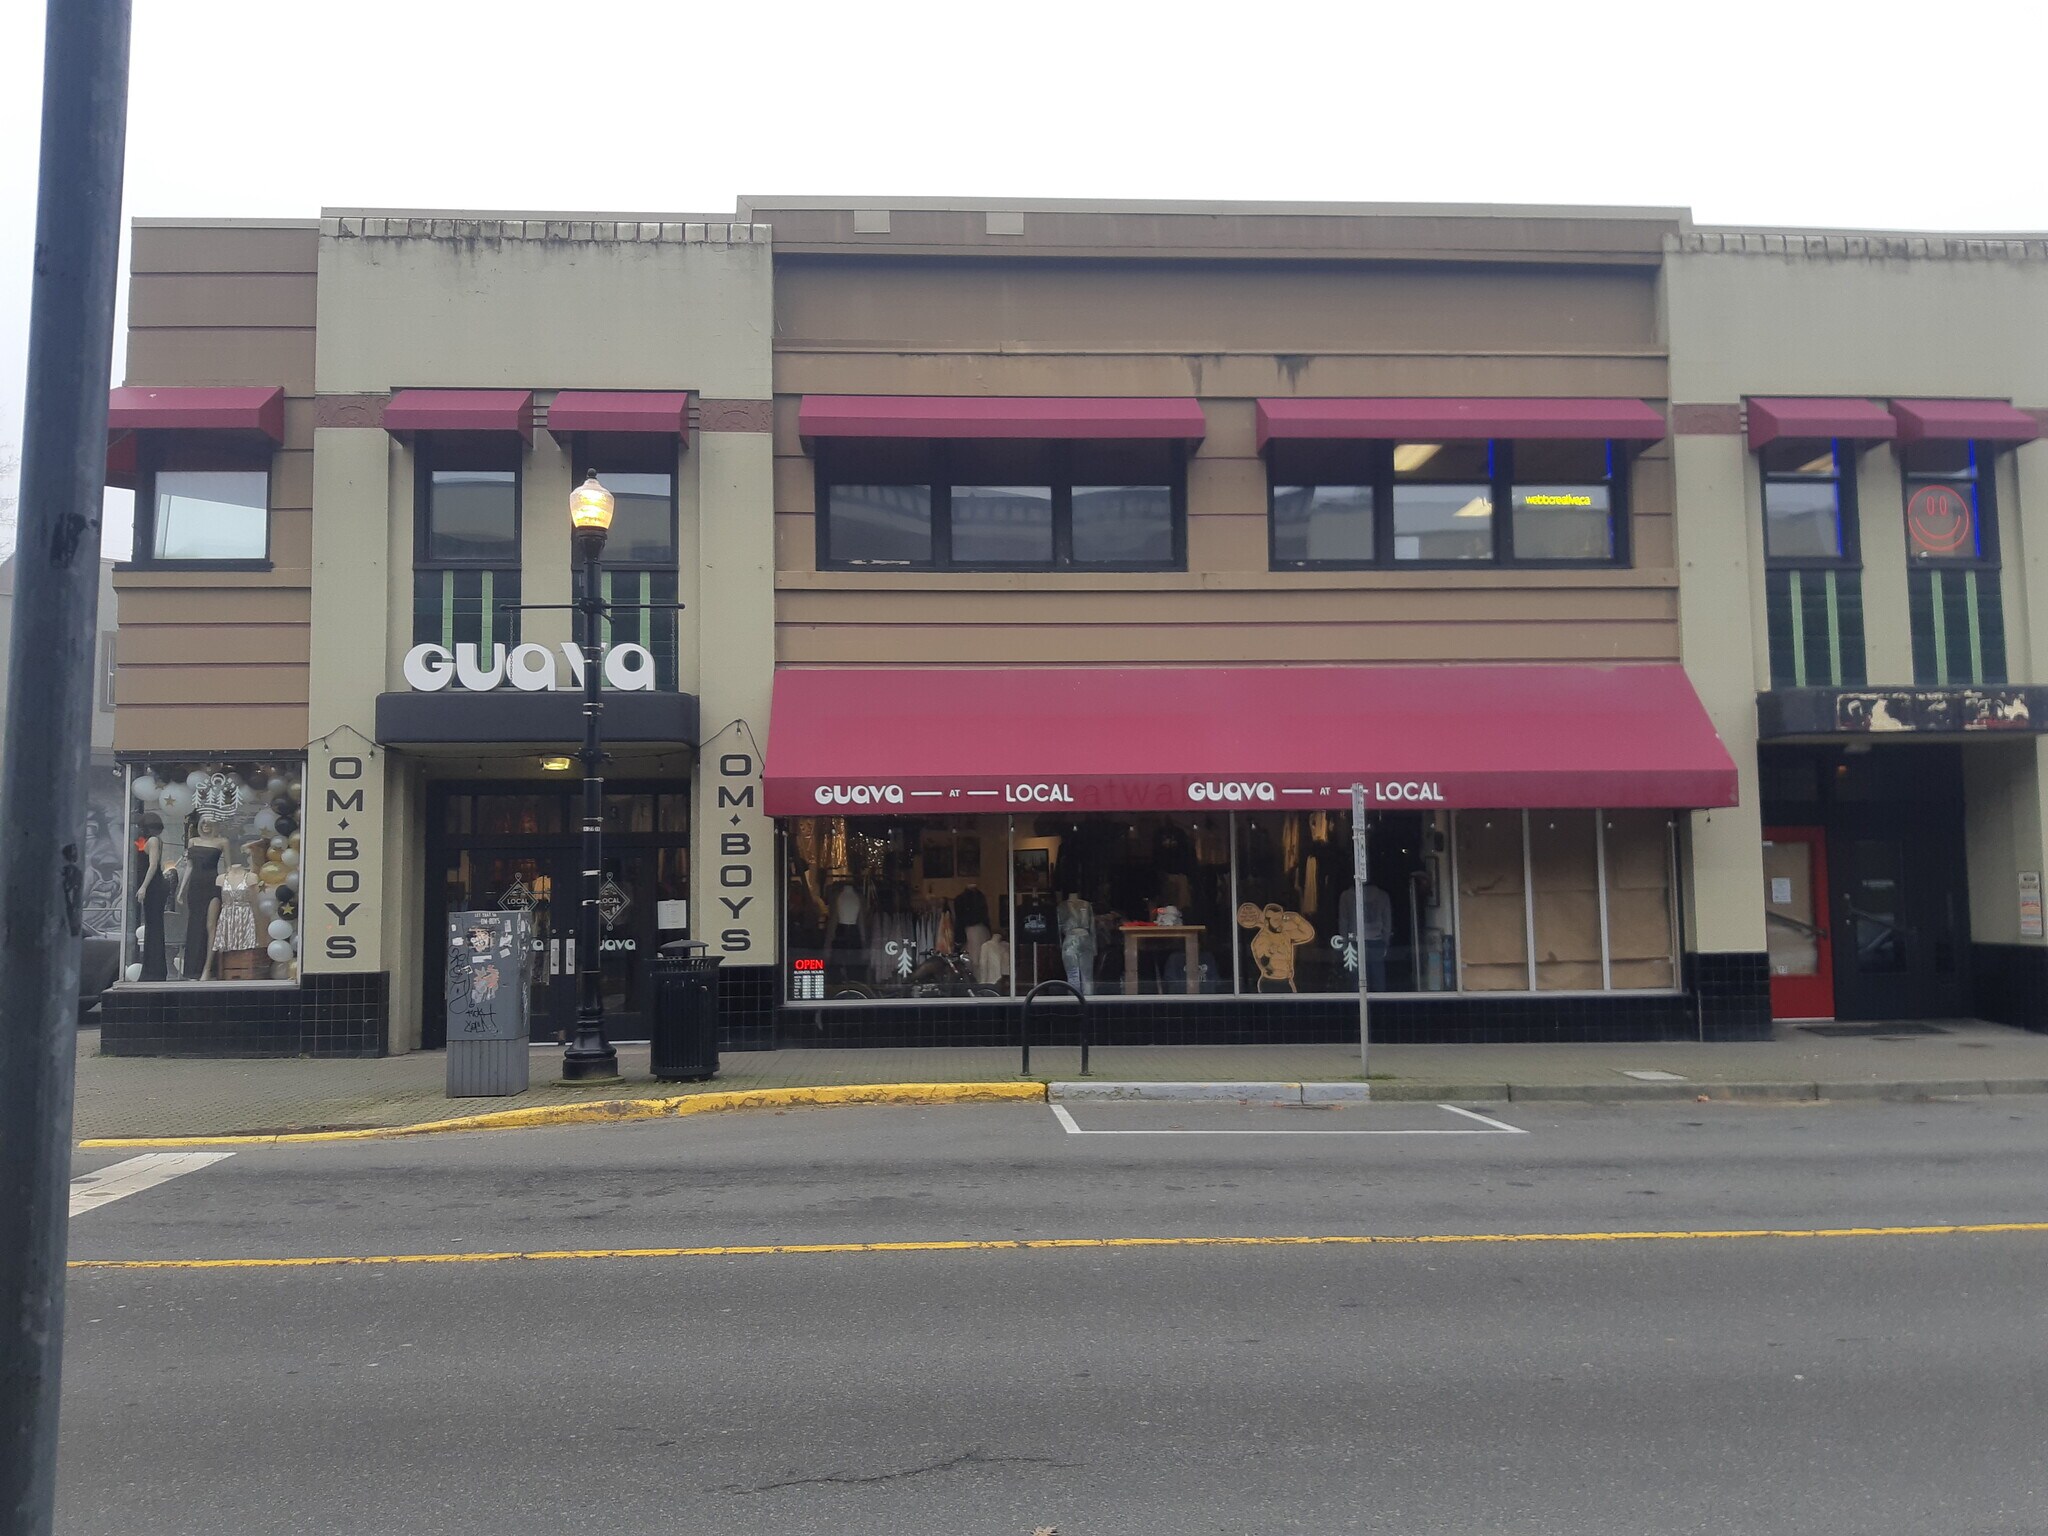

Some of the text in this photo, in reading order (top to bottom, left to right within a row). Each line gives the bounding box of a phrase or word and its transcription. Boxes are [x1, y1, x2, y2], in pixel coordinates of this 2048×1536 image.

[948, 788, 961, 798] AT
[1005, 783, 1074, 803] LOCAL
[1319, 786, 1331, 796] AT
[1375, 781, 1444, 801] LOCAL
[795, 959, 824, 970] OPEN
